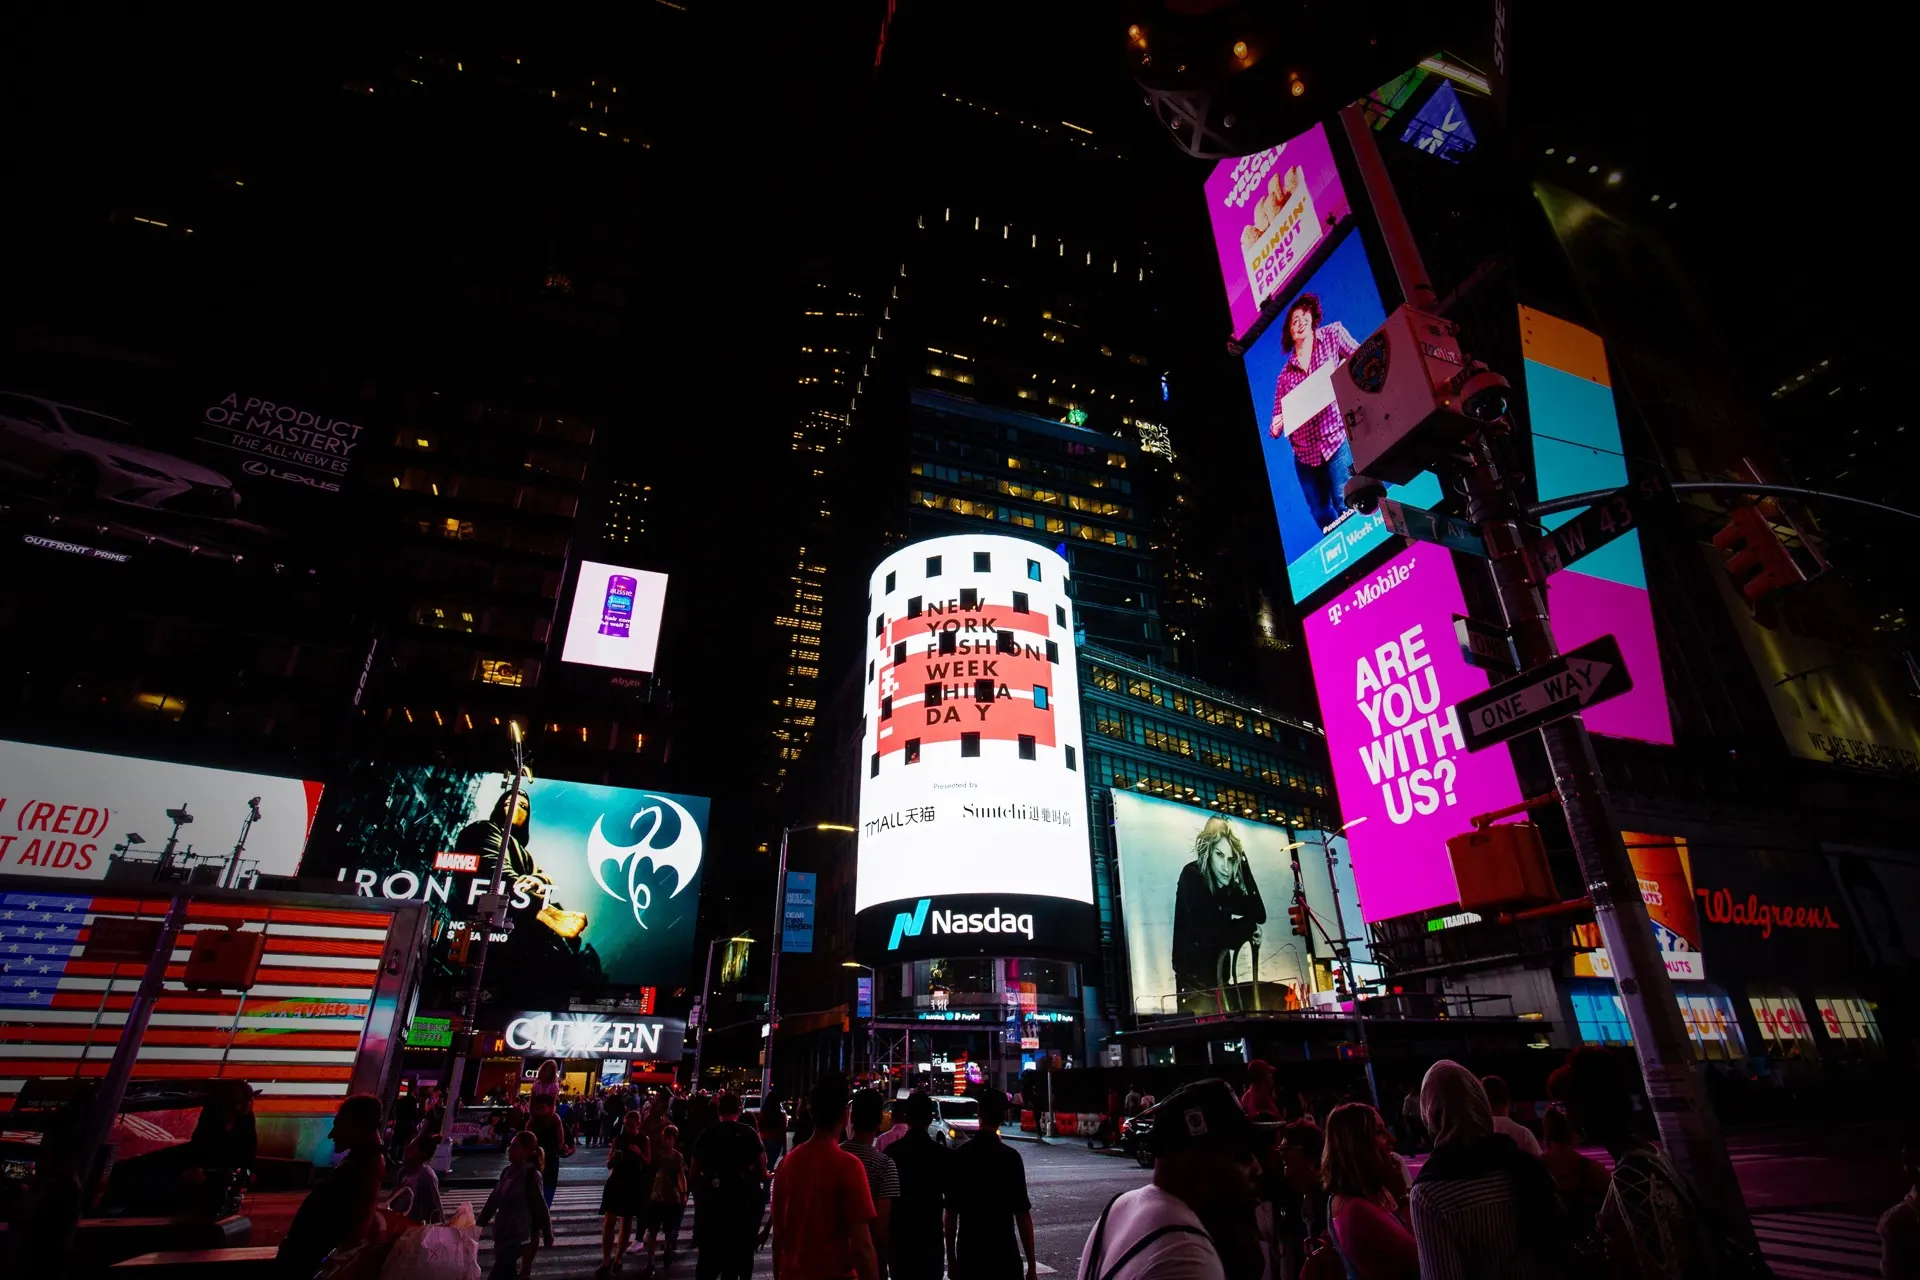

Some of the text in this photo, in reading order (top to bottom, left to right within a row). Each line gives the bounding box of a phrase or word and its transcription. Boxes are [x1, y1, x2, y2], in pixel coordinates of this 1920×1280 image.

[1252, 196, 1306, 271] DUNKIN'
[1255, 219, 1302, 283] DONUT
[1257, 247, 1295, 295] FRIES
[205, 406, 358, 456] OF MASTERY
[220, 392, 364, 439] A PRODUCT
[231, 434, 348, 473] THE ALL-NEW ES
[269, 469, 341, 493] LEXUS
[1560, 519, 1587, 557] W
[1600, 495, 1634, 533] 43
[93, 549, 127, 562] PRIME
[926, 618, 998, 637] YORK
[611, 676, 640, 687] Absen
[925, 660, 999, 680] WEEK
[1356, 623, 1432, 701] ARE
[1357, 664, 1441, 738] YOU
[1481, 663, 1595, 729] ONE WAY
[1358, 704, 1465, 785] WITH
[933, 781, 979, 791] Presented by
[1382, 758, 1458, 825] US?
[17, 799, 109, 839] (RED)
[16, 838, 98, 870] AIDS
[435, 853, 477, 872] MARVEL
[932, 907, 1034, 940] Nasdaq
[1697, 887, 1841, 940] Walgreens
[961, 1012, 981, 1021] PayPal
